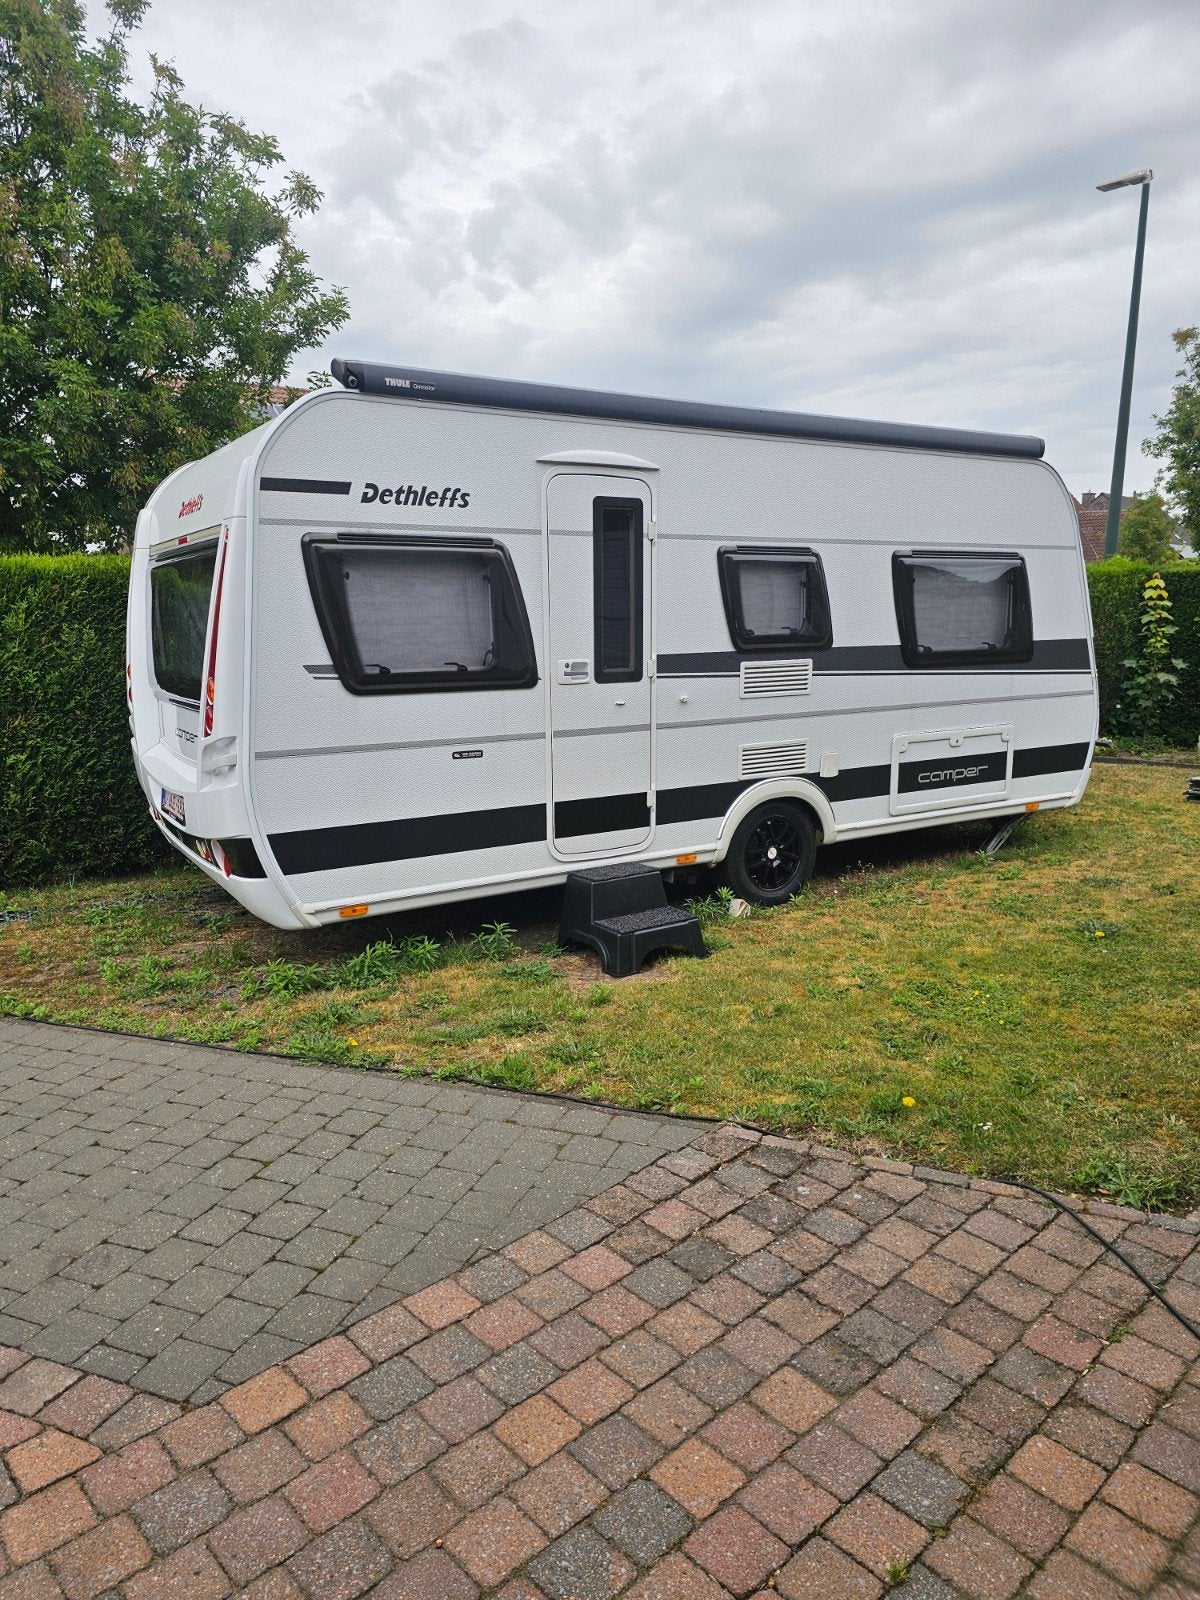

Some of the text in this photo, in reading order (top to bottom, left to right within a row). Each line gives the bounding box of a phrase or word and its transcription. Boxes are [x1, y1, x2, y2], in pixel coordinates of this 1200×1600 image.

[385, 377, 410, 388] THULE
[178, 493, 204, 518] Dethleffs
[361, 482, 470, 508] Dethleffs
[918, 765, 988, 783] camper
